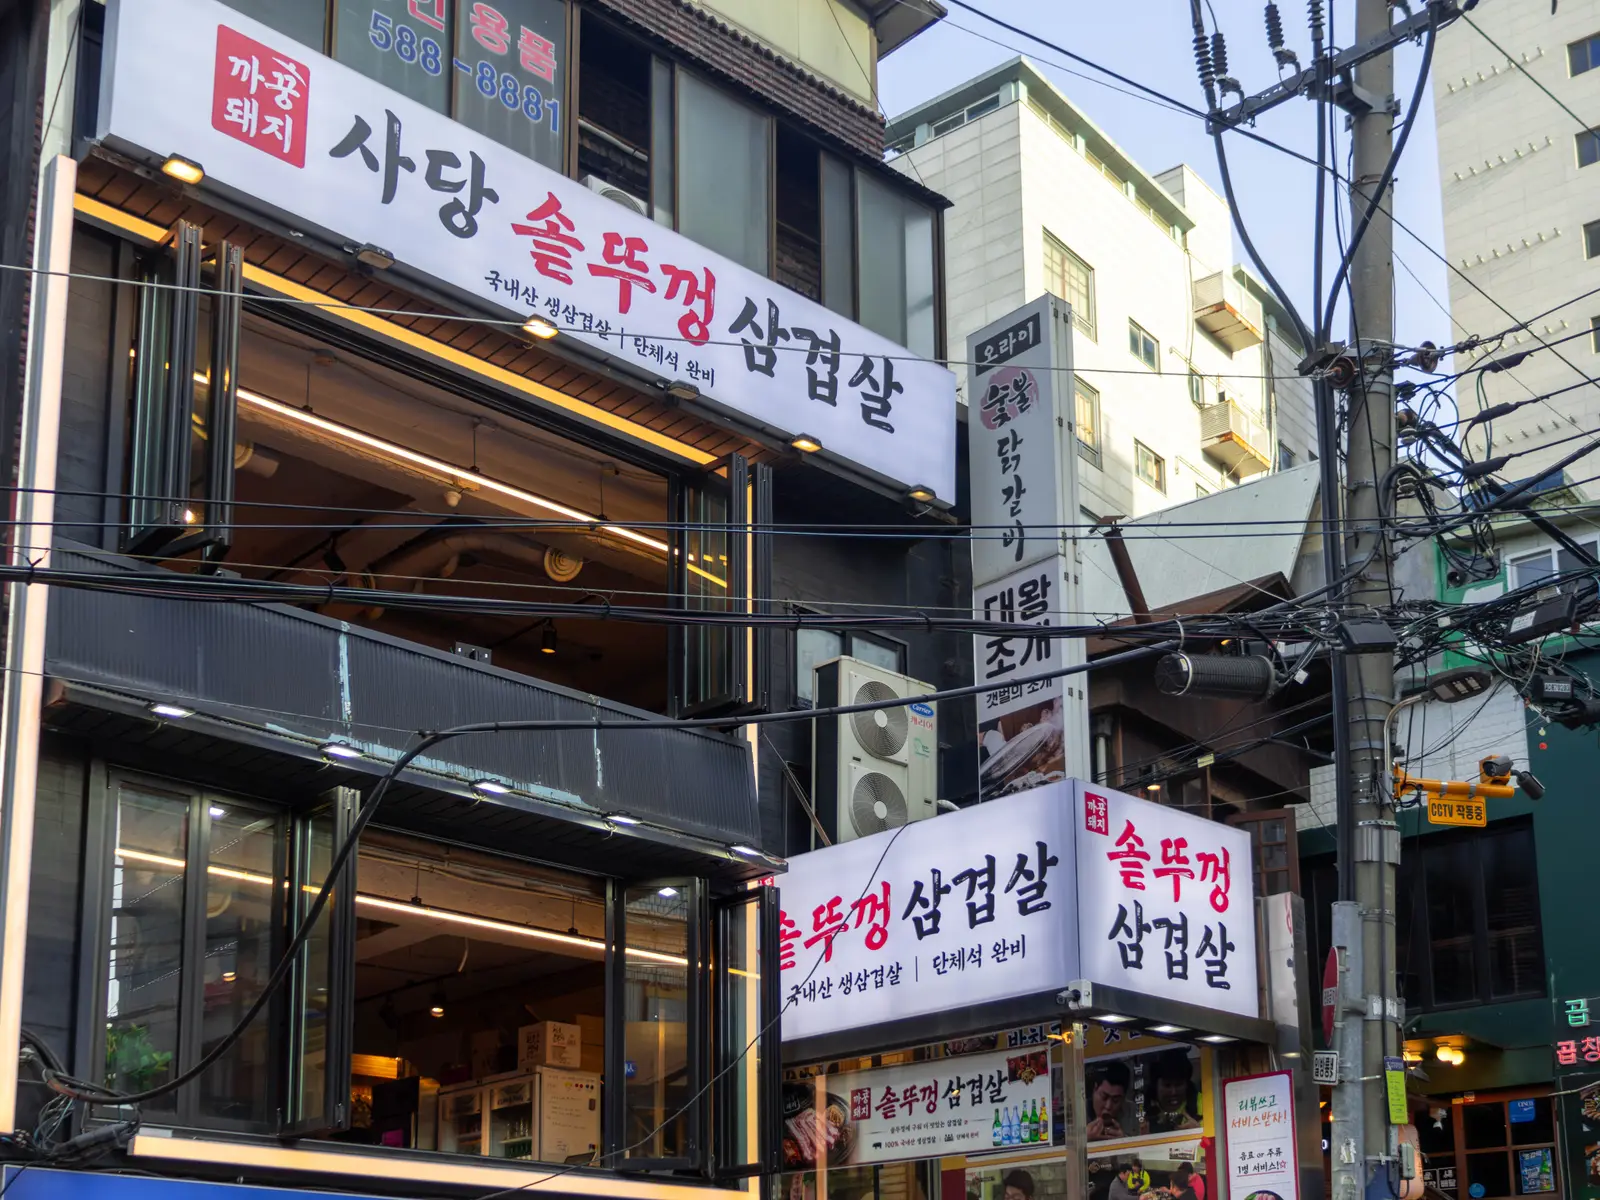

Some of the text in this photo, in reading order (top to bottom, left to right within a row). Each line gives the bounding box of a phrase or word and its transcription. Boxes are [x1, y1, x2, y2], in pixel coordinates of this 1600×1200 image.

[224, 97, 293, 153] 돼지
[329, 109, 904, 434] 사당 솥뚜껑 삼겹살
[485, 270, 715, 387] 국내산 생삼겹살 단체석 완비
[983, 321, 1034, 366] 오라이
[997, 429, 1026, 562] 닭갈비
[984, 574, 1051, 621] 대왕
[1431, 802, 1483, 821] CCTV 작동중
[902, 841, 1058, 941] 삼겹살
[1106, 819, 1231, 913] 솥뚜껑
[787, 934, 1026, 1007] 국내산 생삼겹살 단체석 완비
[1108, 900, 1235, 990] 삼겹살
[875, 1069, 1009, 1120] 솥뚜껑 삼겹살
